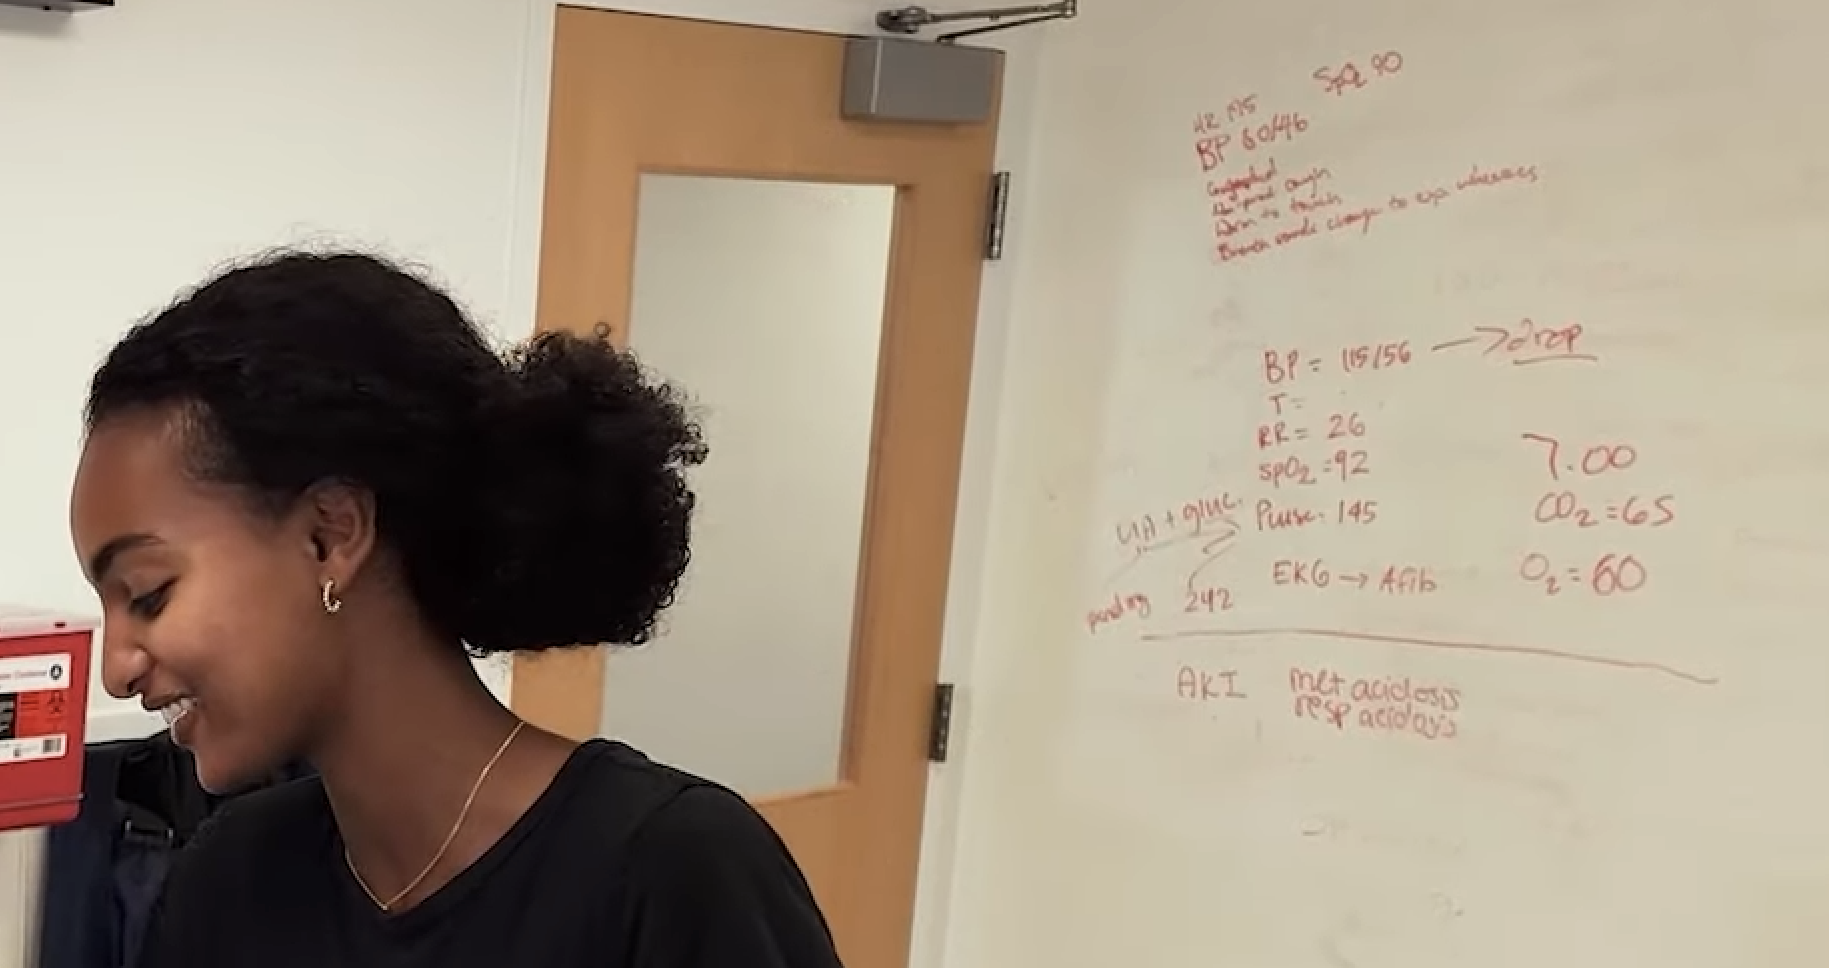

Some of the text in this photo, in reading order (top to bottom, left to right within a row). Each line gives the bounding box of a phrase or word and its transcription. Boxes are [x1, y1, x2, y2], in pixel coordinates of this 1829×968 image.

[1264, 349, 1299, 384] BP
[1327, 411, 1367, 440] 26
[1338, 499, 1378, 525] 145
[1273, 557, 1330, 588] EKG
